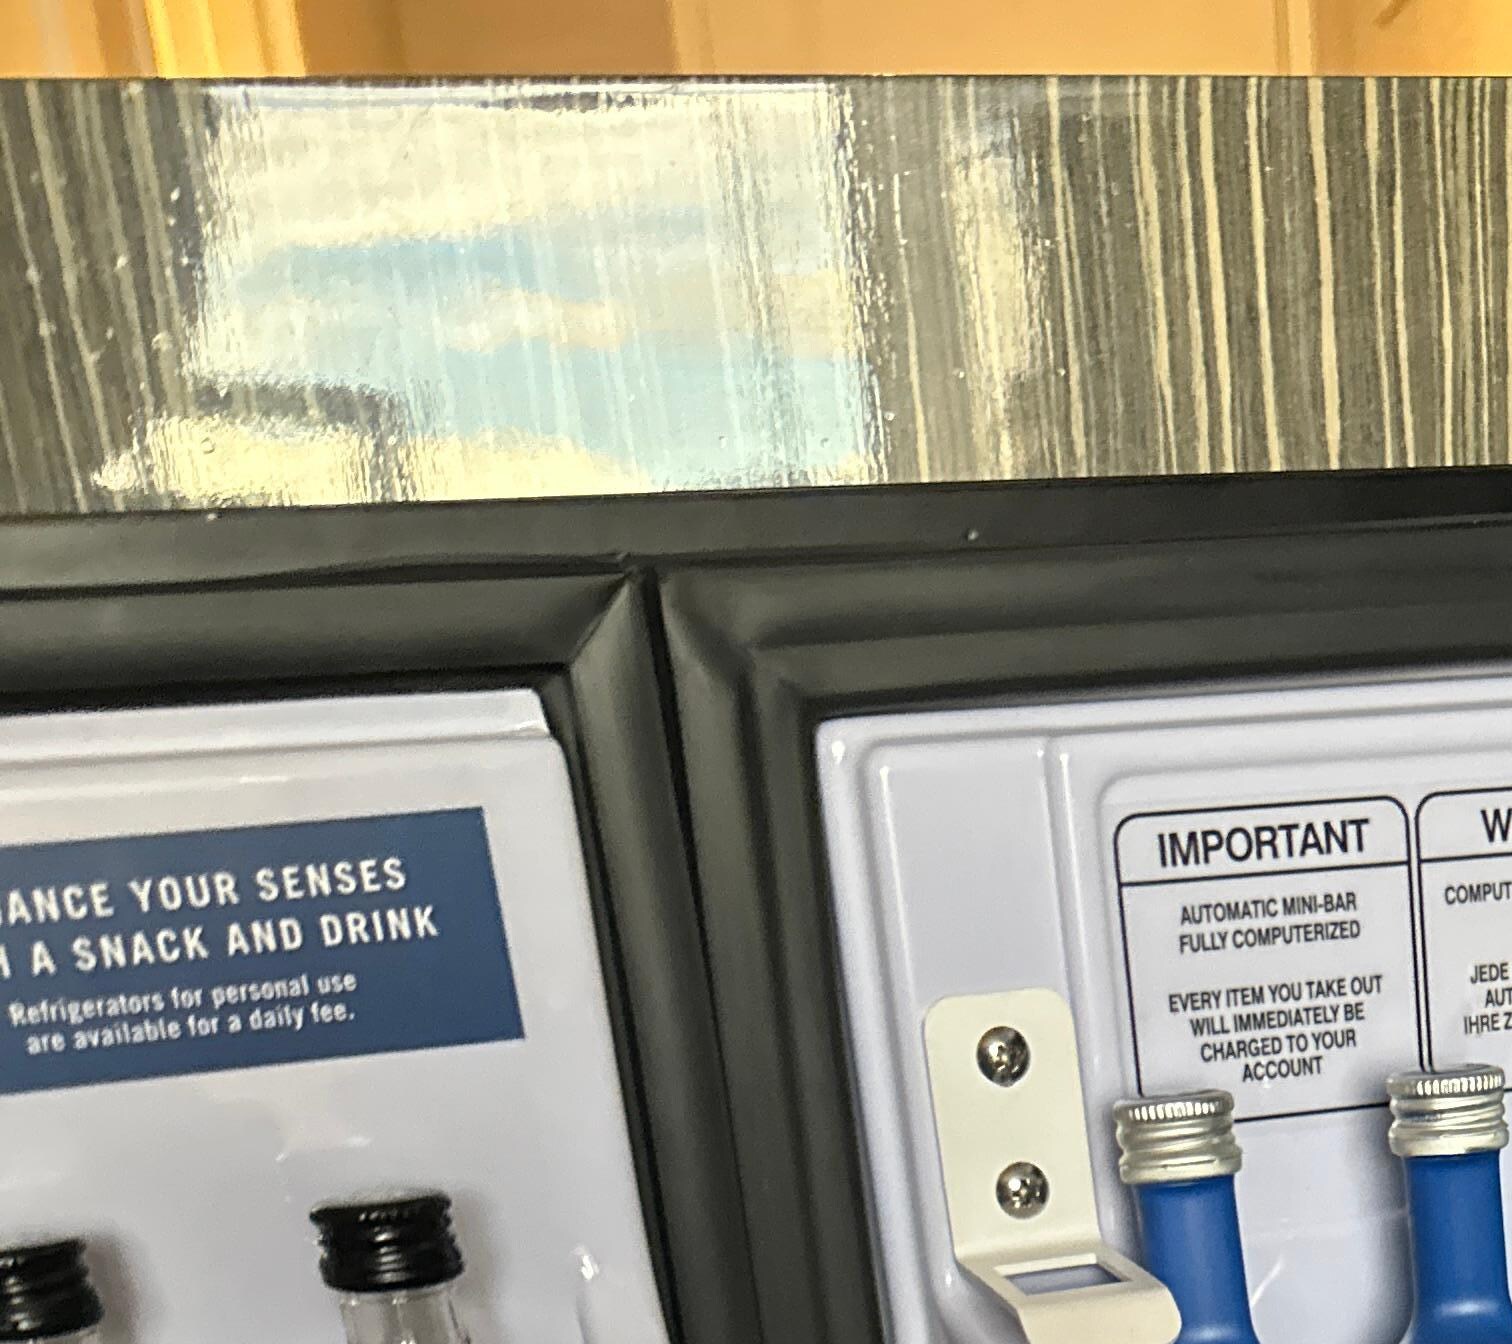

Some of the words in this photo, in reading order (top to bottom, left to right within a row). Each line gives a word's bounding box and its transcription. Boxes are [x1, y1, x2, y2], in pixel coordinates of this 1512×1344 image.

[1158, 818, 1370, 868] IMPORTANT
[0, 882, 115, 926] ANCE
[129, 871, 240, 914] YOUR
[257, 857, 407, 902] SENSES
[1181, 899, 1278, 926] AUTOMATIC
[1283, 892, 1358, 917] MINI-BAR
[31, 942, 57, 978] A
[74, 926, 209, 973] SNACK
[227, 917, 303, 958] AND
[321, 904, 439, 948] DRINK
[1179, 931, 1228, 954] FULLY
[1232, 920, 1361, 948] COMPUTERIZED
[1470, 962, 1509, 985] JEDE
[9, 992, 165, 1027] Refrigerators
[171, 987, 202, 1009] for
[211, 974, 309, 1008] personal
[317, 974, 357, 995] use
[1168, 990, 1221, 1013] EVERY
[1226, 986, 1264, 1008] ITEM
[1268, 983, 1301, 1003] YOU
[1305, 977, 1347, 999] TAKE
[1350, 975, 1383, 995] OUT
[26, 1034, 66, 1056] are
[72, 1015, 181, 1051] available
[187, 1013, 219, 1036] for
[227, 1015, 242, 1033] a
[249, 1002, 303, 1033] daily
[310, 1001, 355, 1024] fee.
[1190, 1016, 1230, 1037] WILL
[1234, 1005, 1340, 1033] IMMEDIATELY
[1344, 1002, 1365, 1021] BE
[1464, 1012, 1500, 1035] IHRE
[1200, 1039, 1283, 1063] CHARGED
[1286, 1034, 1308, 1053] TO
[1311, 1028, 1357, 1051] YOUR
[1242, 1055, 1323, 1083] ACCOUNT
